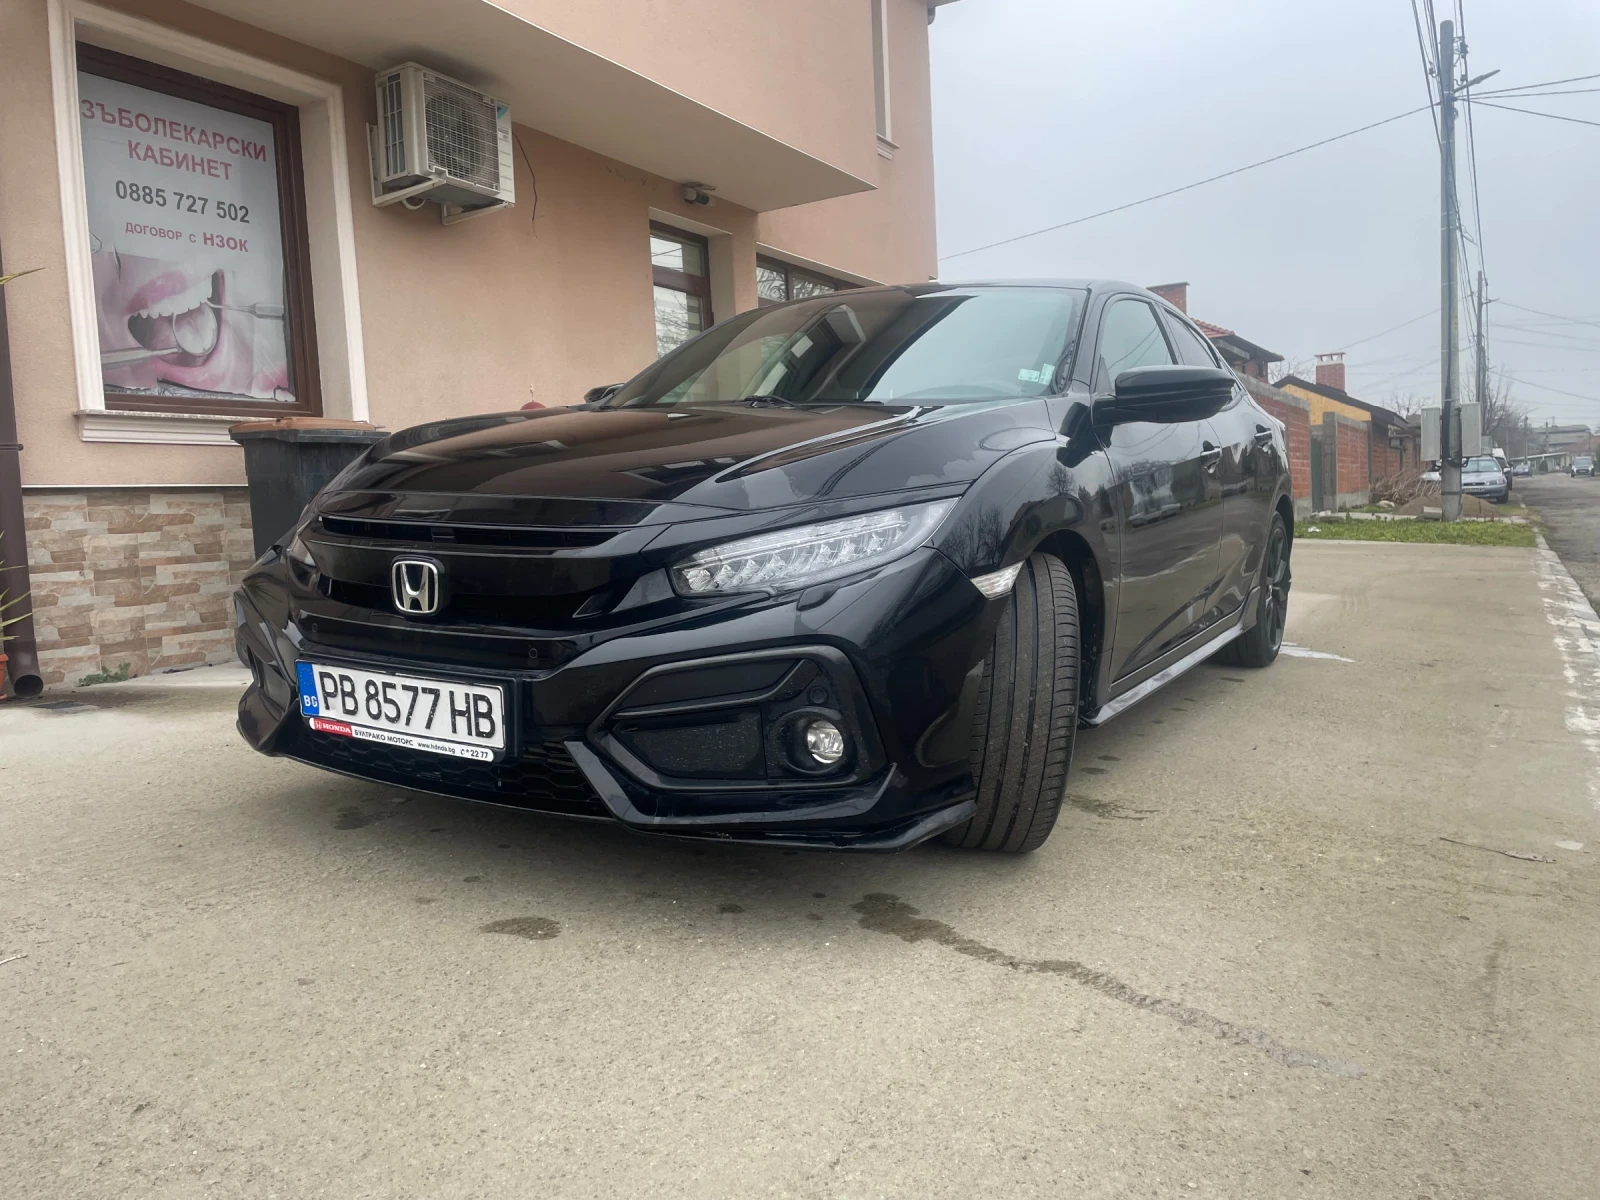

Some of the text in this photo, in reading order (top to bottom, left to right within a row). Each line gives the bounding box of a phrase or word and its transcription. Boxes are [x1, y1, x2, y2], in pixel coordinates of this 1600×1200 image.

[81, 99, 267, 162] ЗЪБОЛЕКАРСКИ
[127, 139, 232, 181] КАБИНЕТ
[115, 179, 250, 224] 0885 727 502
[203, 232, 249, 253] НЗОК
[303, 695, 318, 708] BG
[364, 679, 440, 730] 8577
[322, 723, 351, 734] HONDA
[354, 729, 414, 747] БУЛТРАКО МОТОРС
